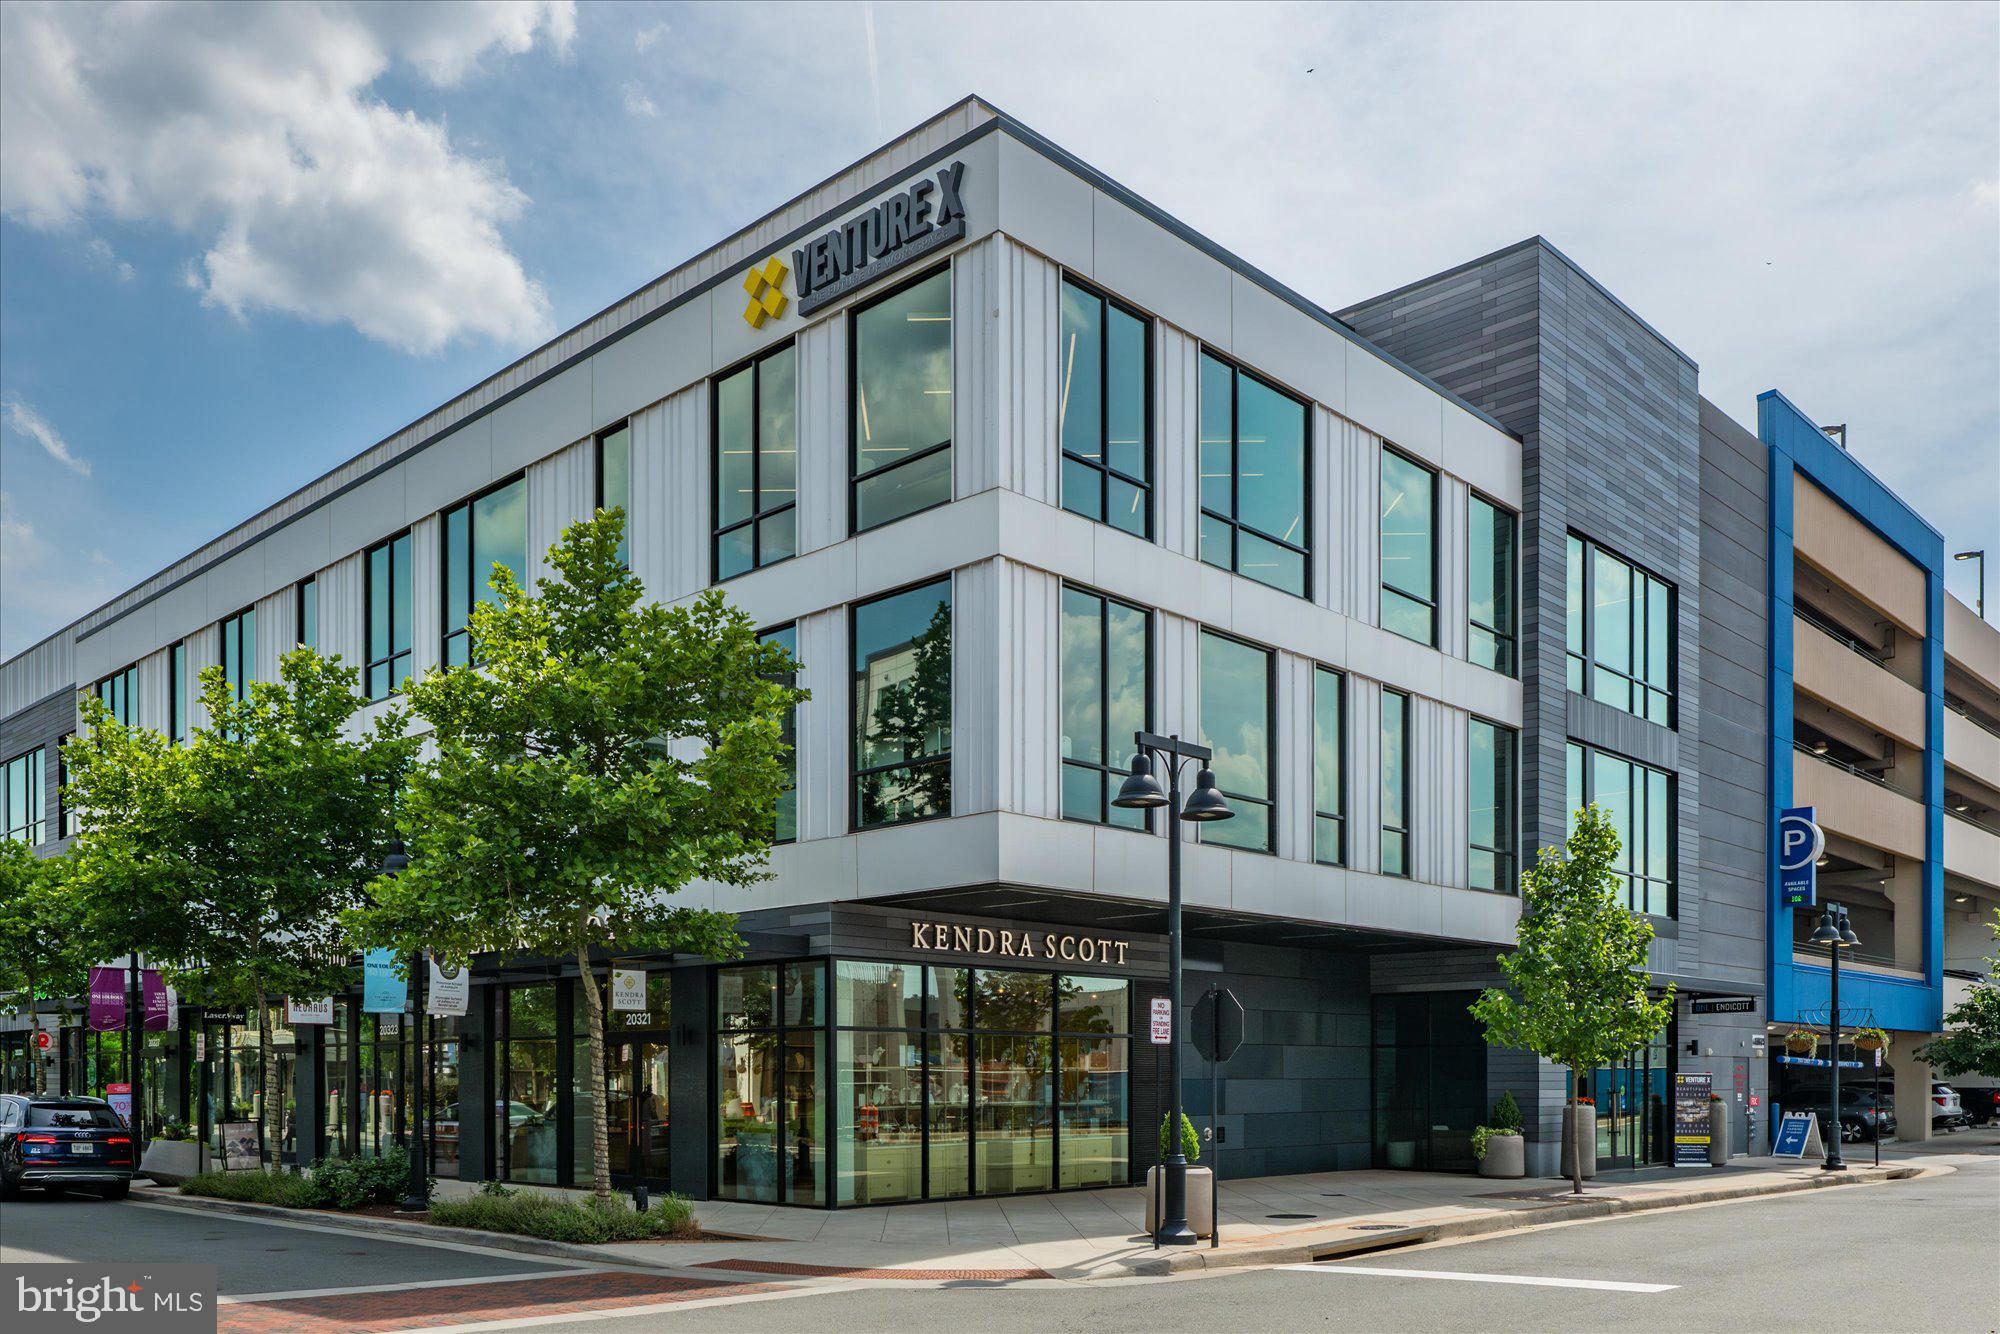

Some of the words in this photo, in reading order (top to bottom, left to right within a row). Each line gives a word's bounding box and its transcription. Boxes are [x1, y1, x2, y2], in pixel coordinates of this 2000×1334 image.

[792, 179, 934, 298] VENTURE
[936, 161, 965, 227] X
[827, 272, 865, 296] FUTURE
[866, 263, 883, 277] OF
[884, 228, 950, 264] WORKSPACE
[1784, 829, 1806, 856] P
[912, 922, 1034, 957] KENDRA
[1046, 934, 1129, 965] SCOTT
[293, 1002, 328, 1013] NEUHAUS
[1716, 1002, 1750, 1011] ENDICOTT
[626, 1013, 651, 1025] 20321
[380, 1024, 399, 1036] 20323
